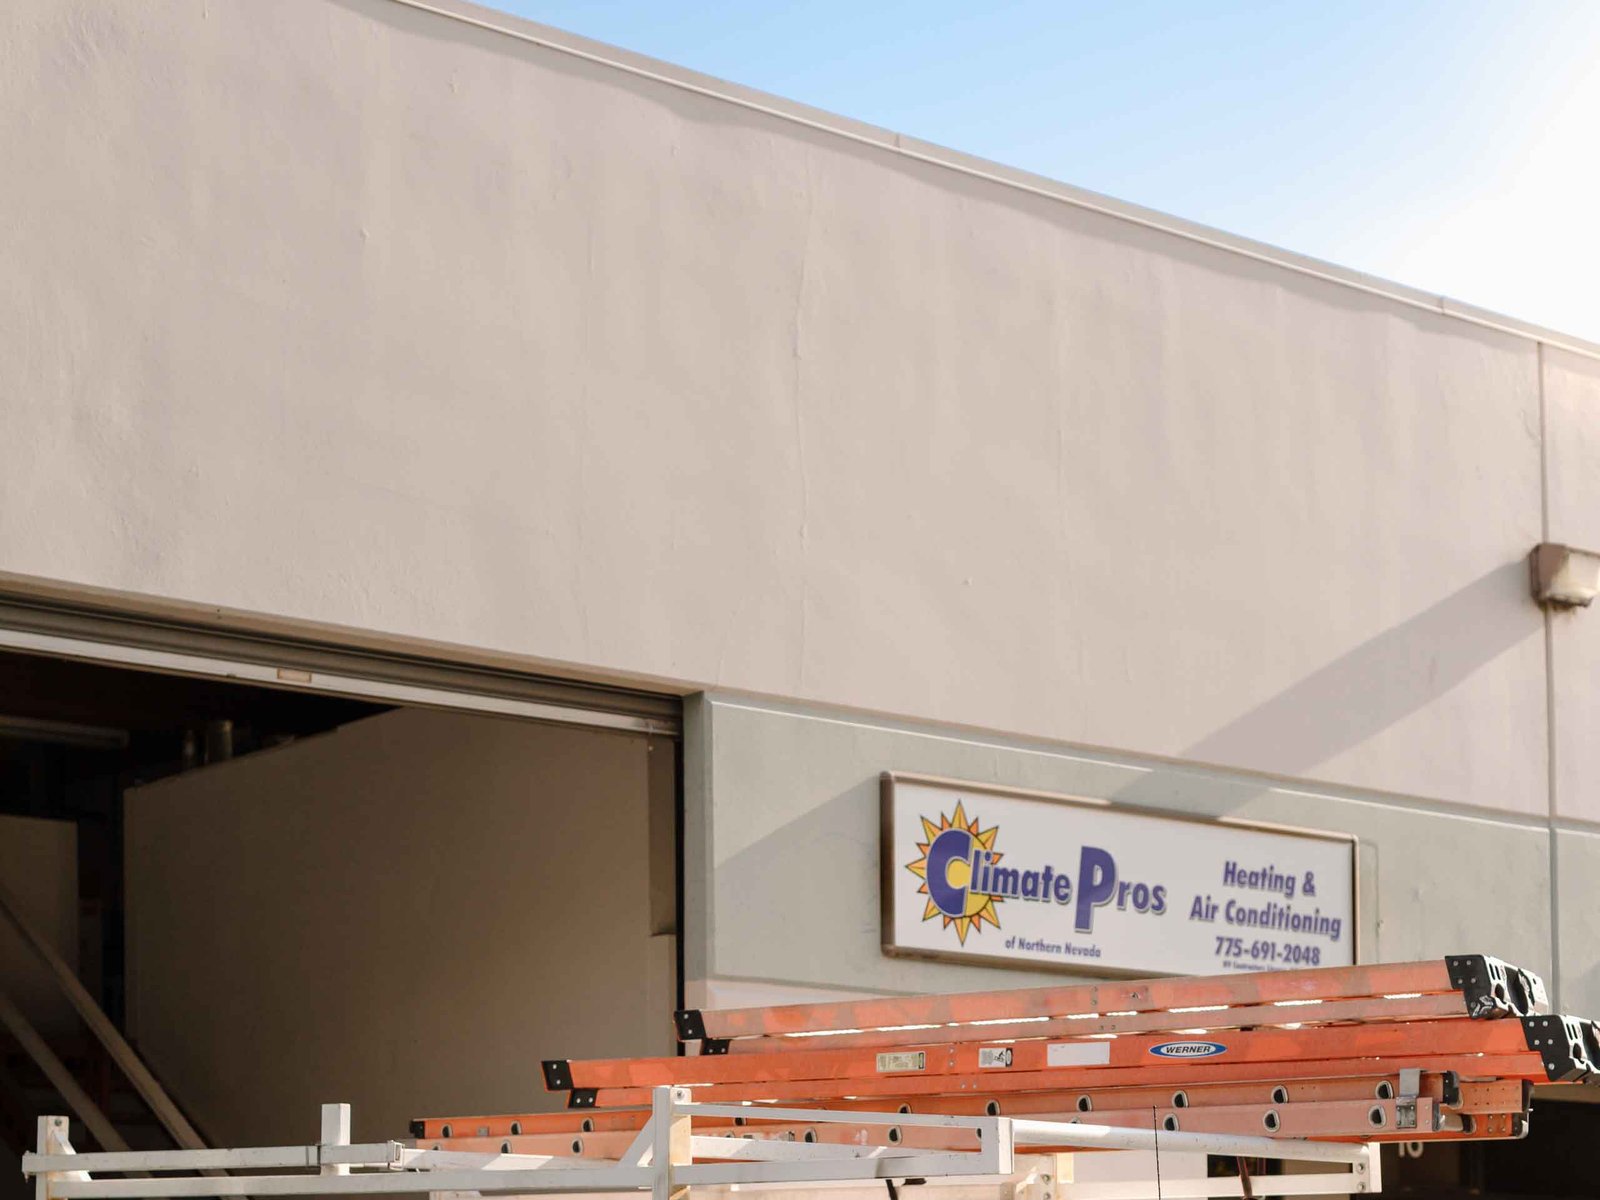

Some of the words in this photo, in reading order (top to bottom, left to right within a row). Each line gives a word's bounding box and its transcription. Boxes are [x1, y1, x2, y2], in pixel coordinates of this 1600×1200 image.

[927, 829, 1072, 919] Climate
[1075, 846, 1166, 933] Pros
[1223, 861, 1296, 896] Heating
[1302, 872, 1315, 896] &
[1190, 896, 1219, 923] Air
[1224, 901, 1342, 939] Conditioning
[1005, 936, 1016, 950] of
[1017, 938, 1062, 955] Northern
[1064, 942, 1101, 958] Nevada
[1214, 936, 1321, 965] 775-691-2048
[1165, 1044, 1212, 1055] WERNER
